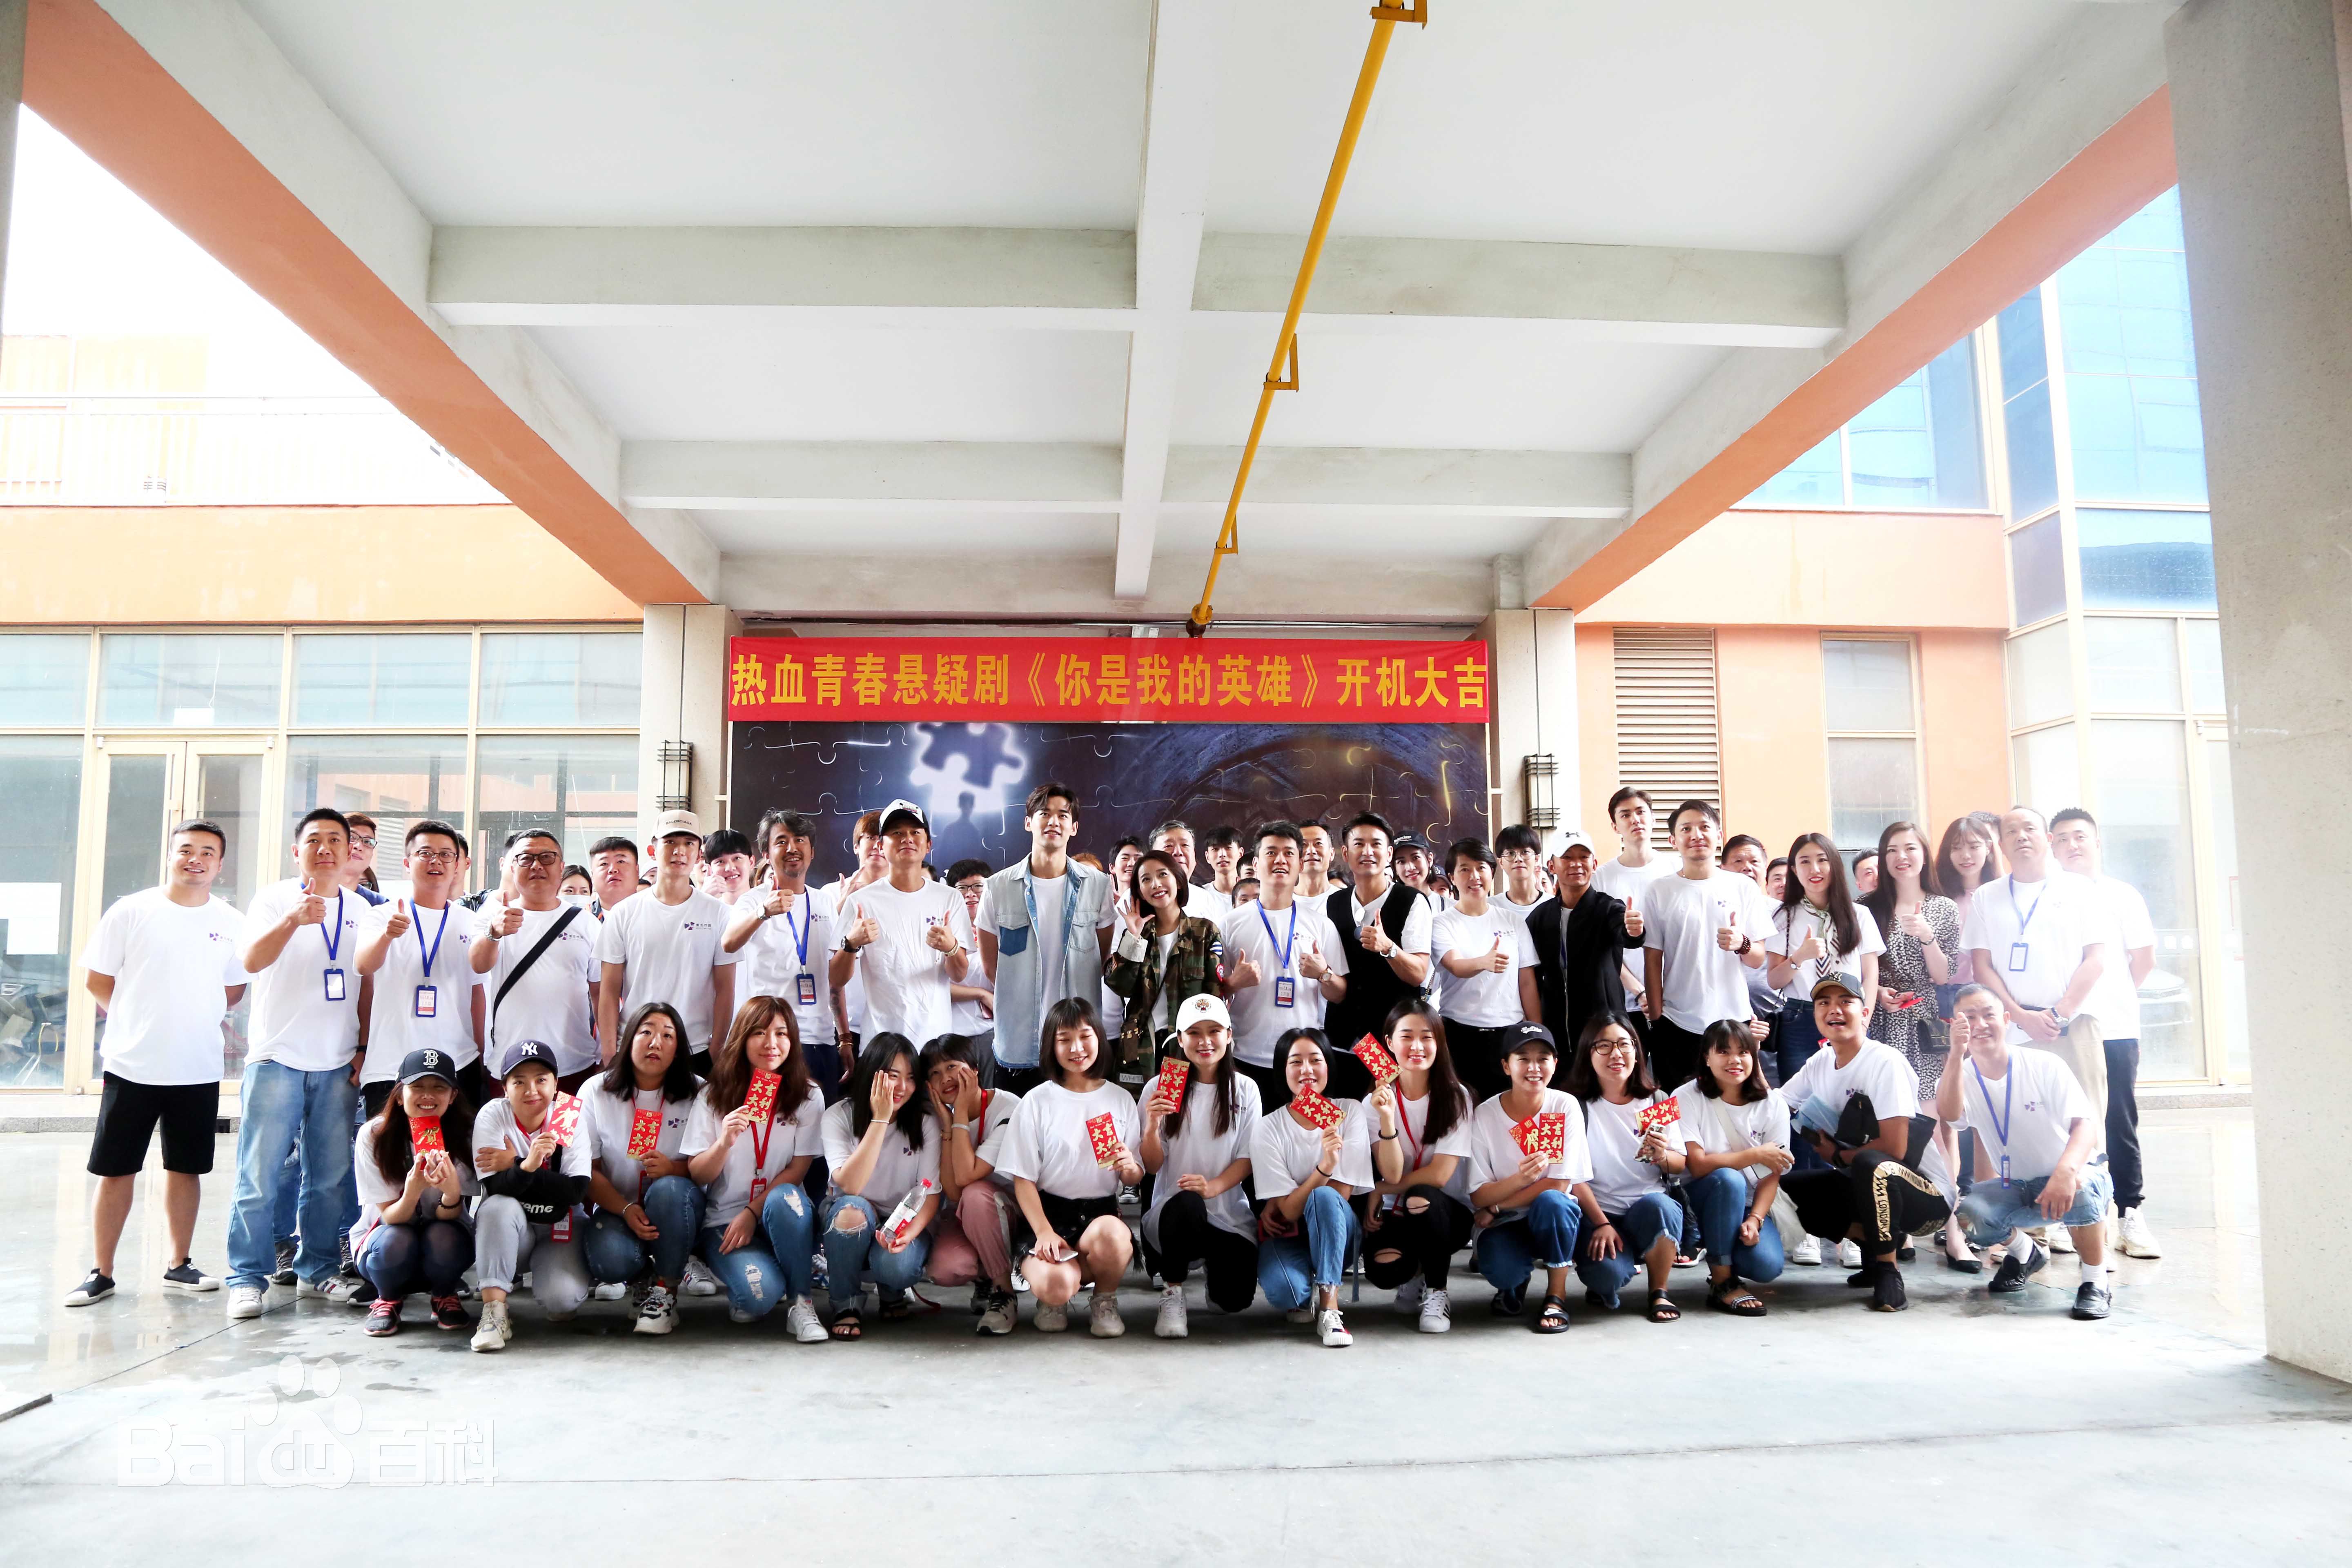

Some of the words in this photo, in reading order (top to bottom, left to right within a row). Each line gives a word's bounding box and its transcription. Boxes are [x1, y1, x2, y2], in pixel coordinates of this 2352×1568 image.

[732, 653, 1486, 708] 热血青春悬疑剧《你是我的英雄》开机大吉
[521, 1042, 538, 1056] NY
[1363, 1042, 1381, 1065] 大吉
[423, 1050, 439, 1066] B
[1371, 1053, 1391, 1076] 大利
[1160, 1072, 1183, 1087] 大利
[751, 1080, 776, 1097] 大吉
[746, 1094, 772, 1110] 大利
[1301, 1092, 1321, 1117] 大吉
[1314, 1100, 1333, 1125] 大利
[634, 1119, 659, 1134] 大吉
[1092, 1123, 1114, 1141] 大吉
[1540, 1122, 1564, 1136] 大吉
[631, 1133, 657, 1148] 大利
[1540, 1136, 1563, 1149] 大利
[520, 1202, 554, 1213] eme
[1878, 1200, 1888, 1230] LONDON
